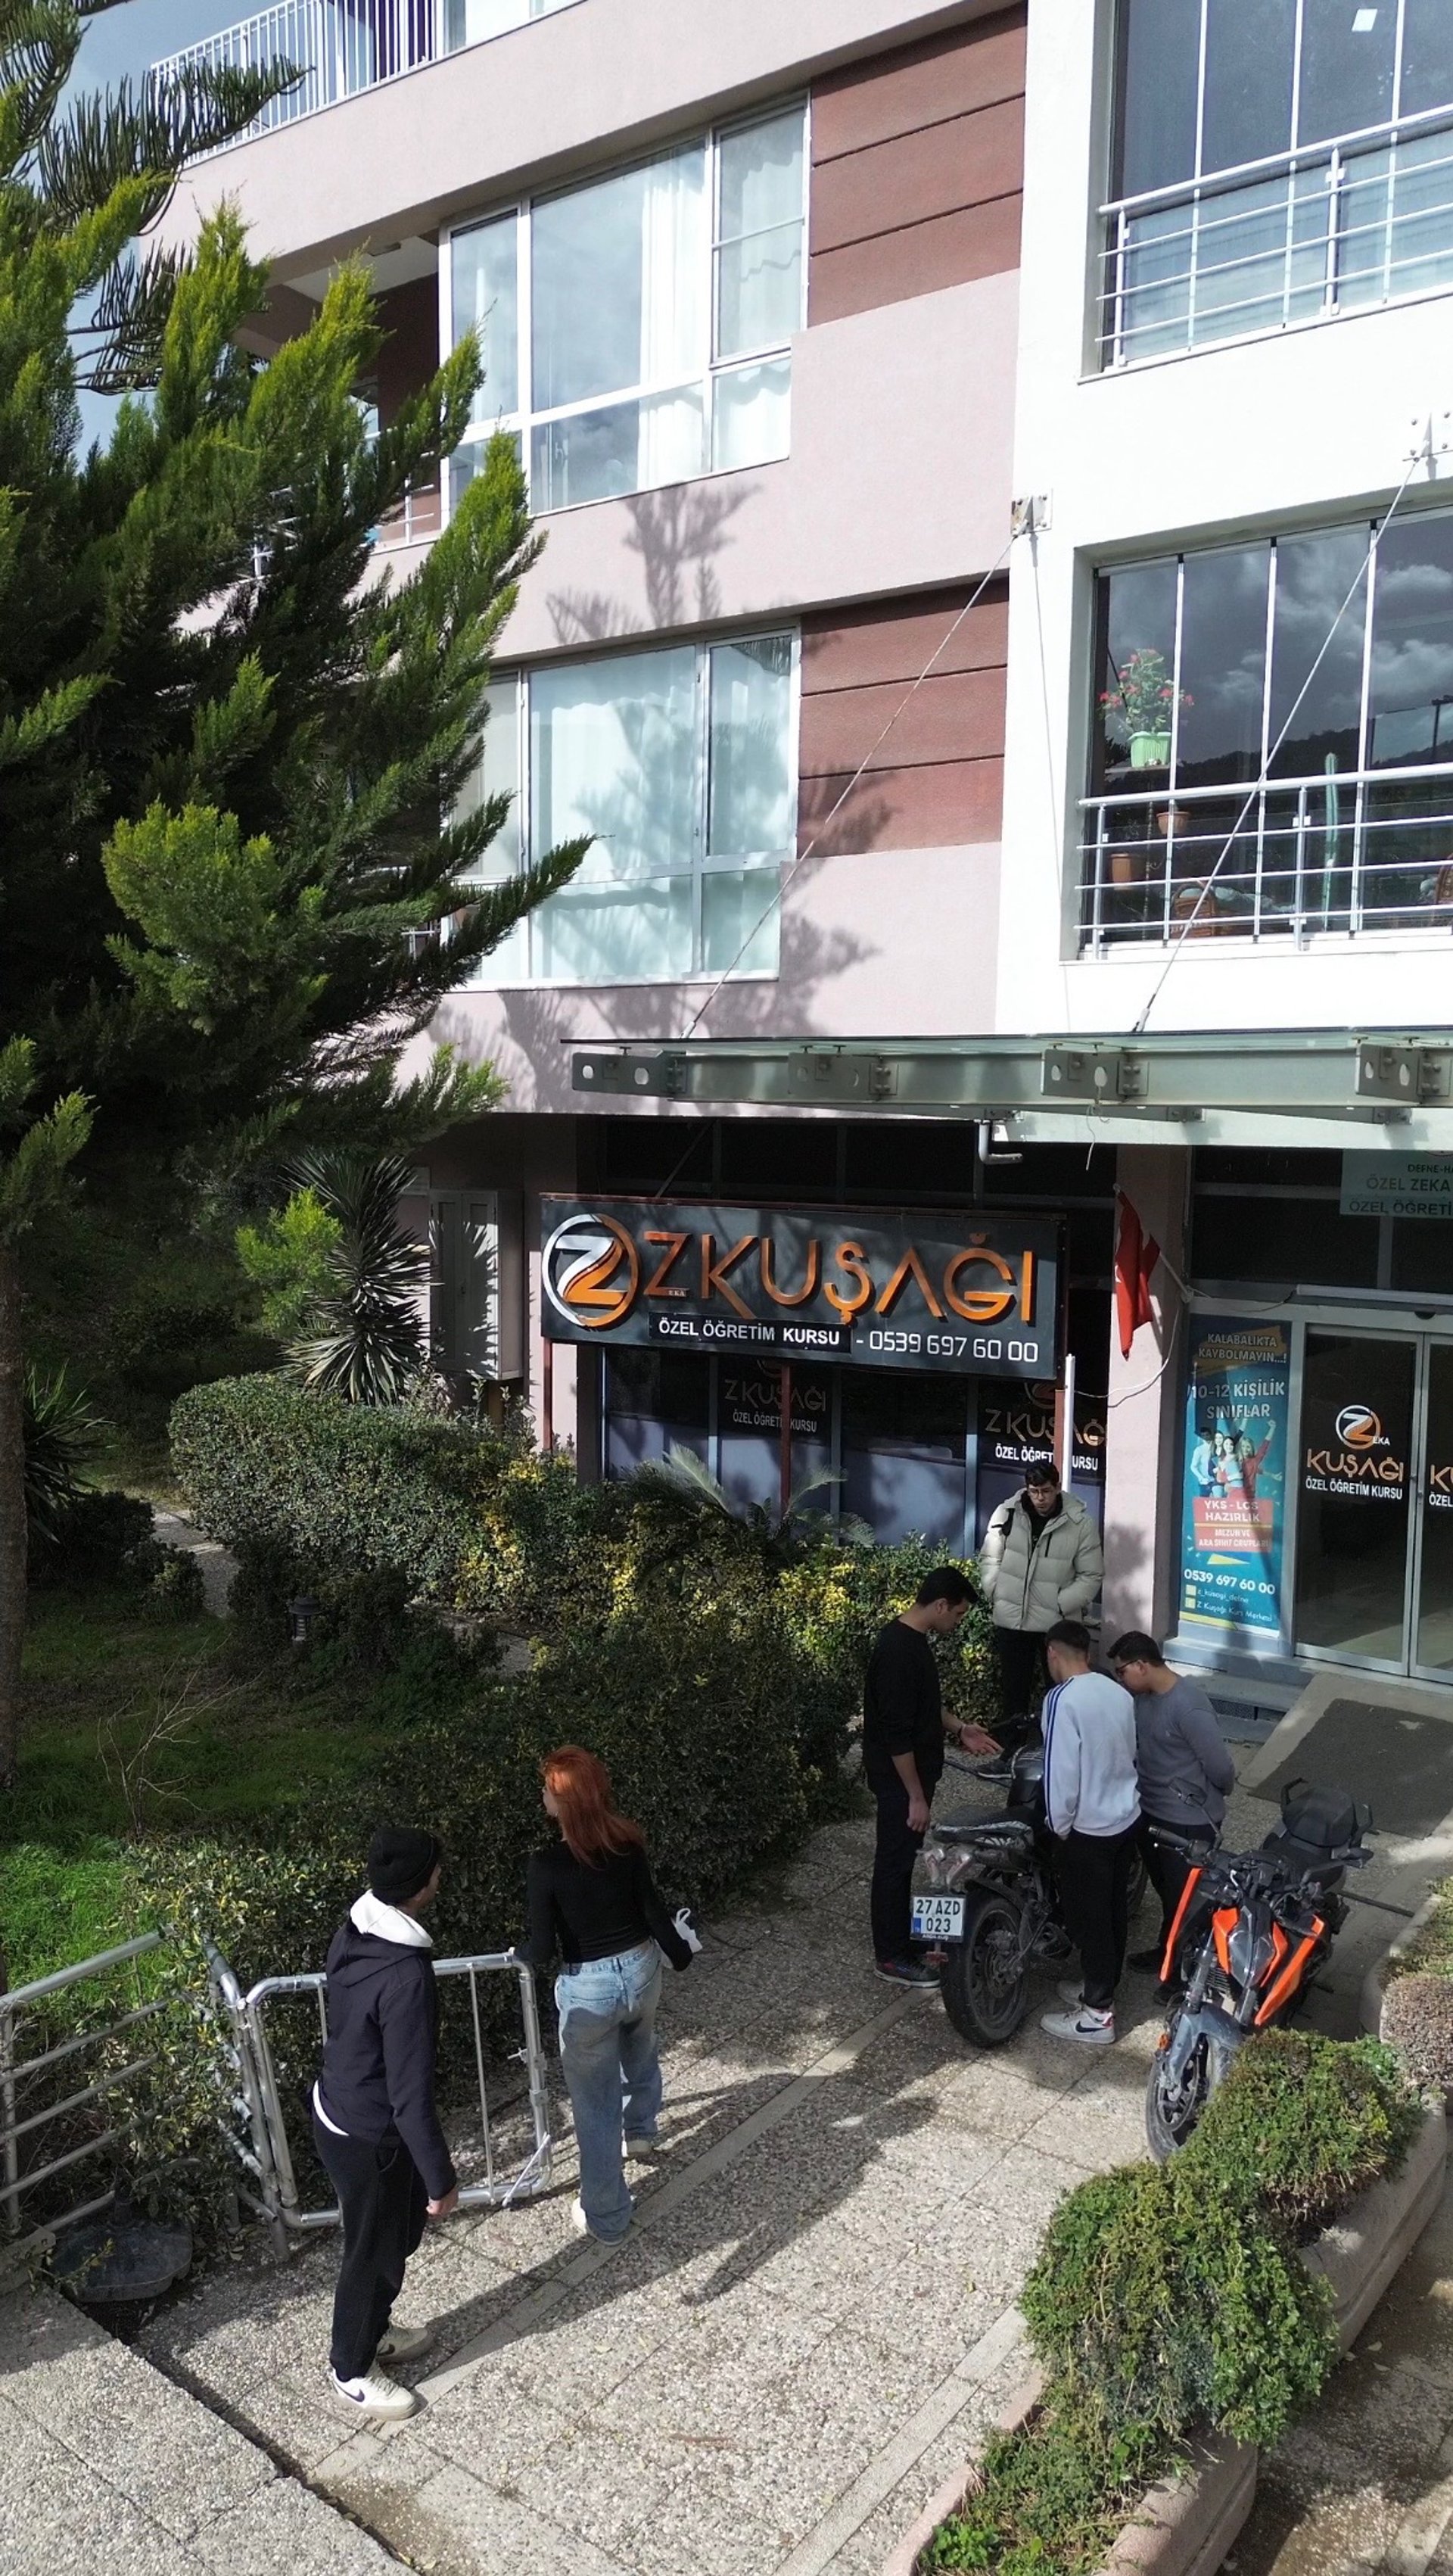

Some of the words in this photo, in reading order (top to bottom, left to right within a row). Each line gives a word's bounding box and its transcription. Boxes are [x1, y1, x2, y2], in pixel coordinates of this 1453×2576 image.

[1408, 1164, 1453, 1173] DEFNE-H
[1367, 1174, 1405, 1191] ÖZEL
[1411, 1179, 1450, 1191] ZEKA
[1350, 1198, 1388, 1213] ÖZEL
[1393, 1199, 1452, 1216] ÖĞRETİ
[658, 1317, 699, 1337] ÖZEL
[702, 1319, 776, 1342] ÖĞRETİM
[783, 1327, 840, 1346] KURSU
[870, 1331, 921, 1353] 0539
[927, 1335, 968, 1357] 697
[973, 1338, 1001, 1360] 60
[1007, 1341, 1038, 1363] 00
[1207, 1333, 1277, 1347] KALABALIKTA
[1234, 1378, 1285, 1400] KİŞİLİK
[1206, 1403, 1271, 1419] SINIFLAR
[733, 1408, 753, 1424] ÖZEL
[754, 1410, 783, 1428] ÖĞRETİ
[790, 1417, 817, 1432] KURSU
[995, 1442, 1019, 1462] ÖZEL
[1021, 1445, 1054, 1463] ÖĞRET
[1072, 1455, 1098, 1472] URSU
[1307, 1448, 1404, 1482] KUŞAĞI
[1305, 1476, 1328, 1491] ÖZEL
[1330, 1478, 1370, 1497] ÖĞRETİM
[1371, 1485, 1403, 1500] KURSU
[1204, 1500, 1227, 1509] YKS
[1205, 1512, 1260, 1522] HAZIRLIK
[1184, 1568, 1213, 1583] 0539
[1215, 1575, 1237, 1587] 697
[1239, 1579, 1255, 1590] 60
[1259, 1582, 1275, 1595] 00
[916, 1899, 932, 1914] 27
[935, 1900, 960, 1915] AZD
[927, 1917, 951, 1933] 023
